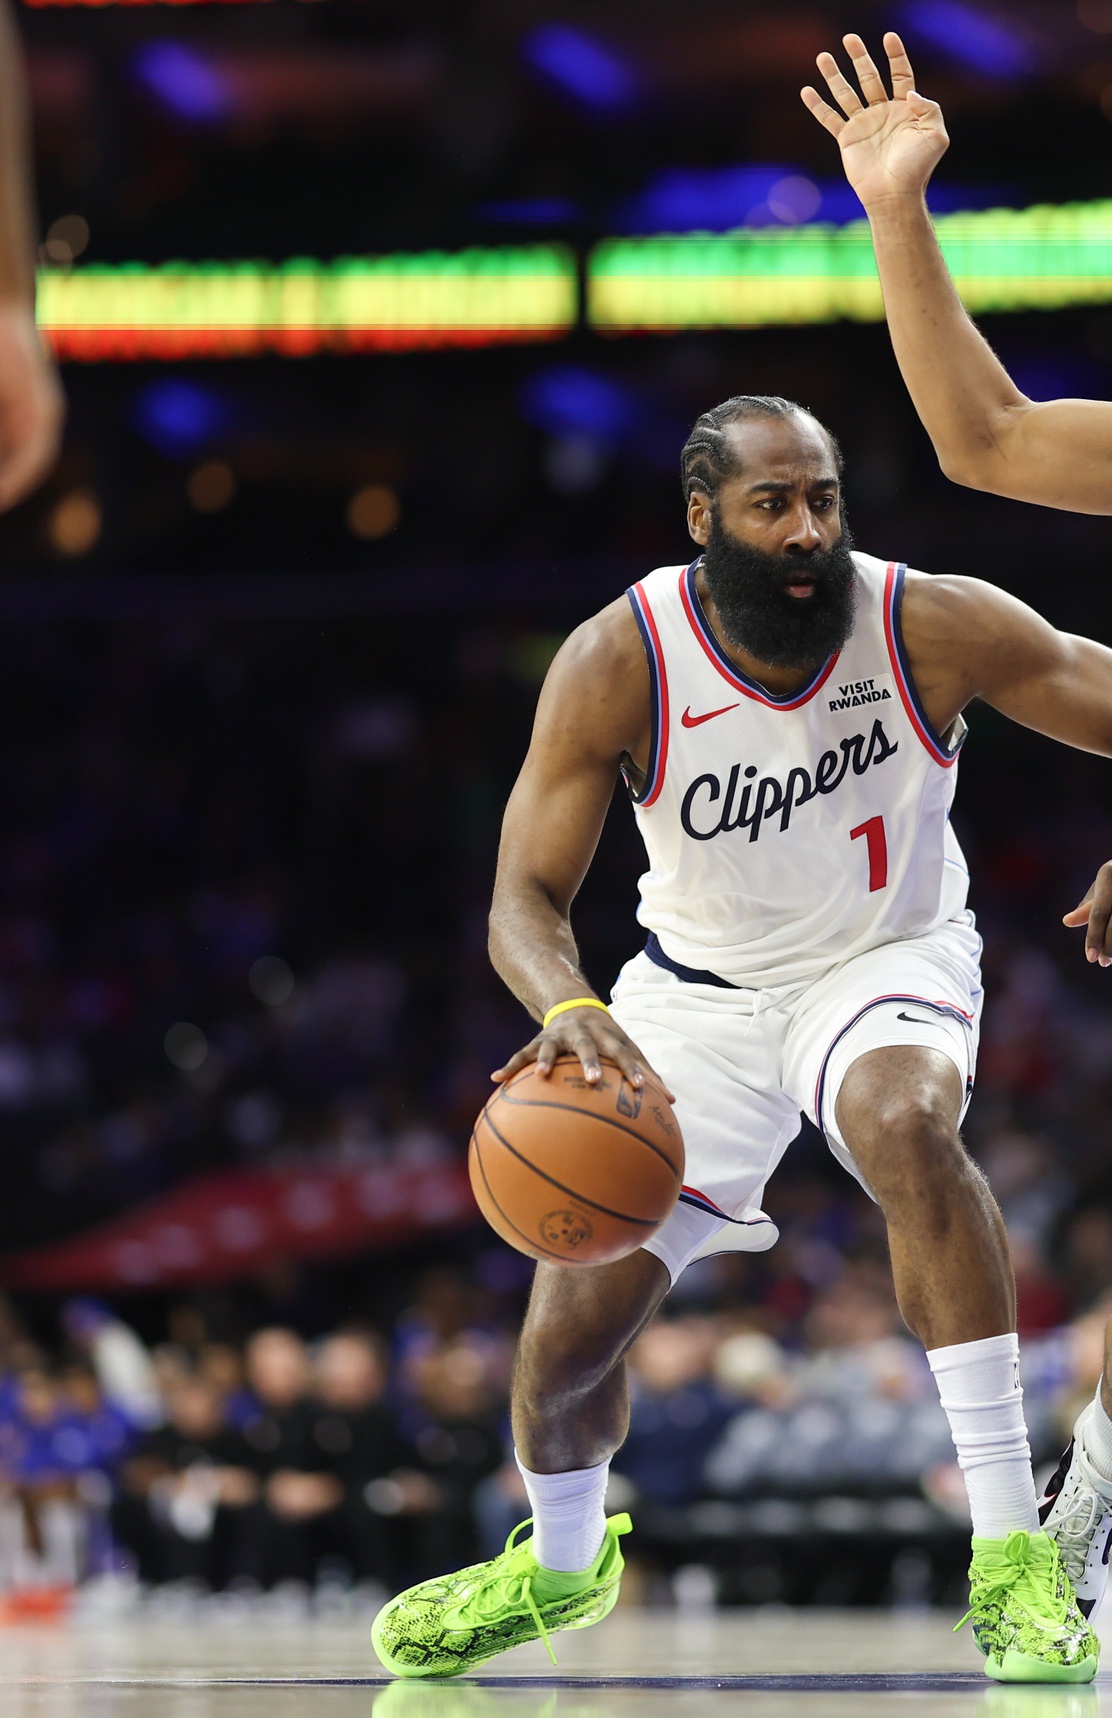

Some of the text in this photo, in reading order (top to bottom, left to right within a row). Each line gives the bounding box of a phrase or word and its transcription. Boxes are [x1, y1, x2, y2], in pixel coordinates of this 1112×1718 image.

[828, 688, 892, 712] RWANDA
[838, 679, 875, 697] VISIT
[680, 718, 899, 843] Clippers
[850, 815, 887, 893] 1
